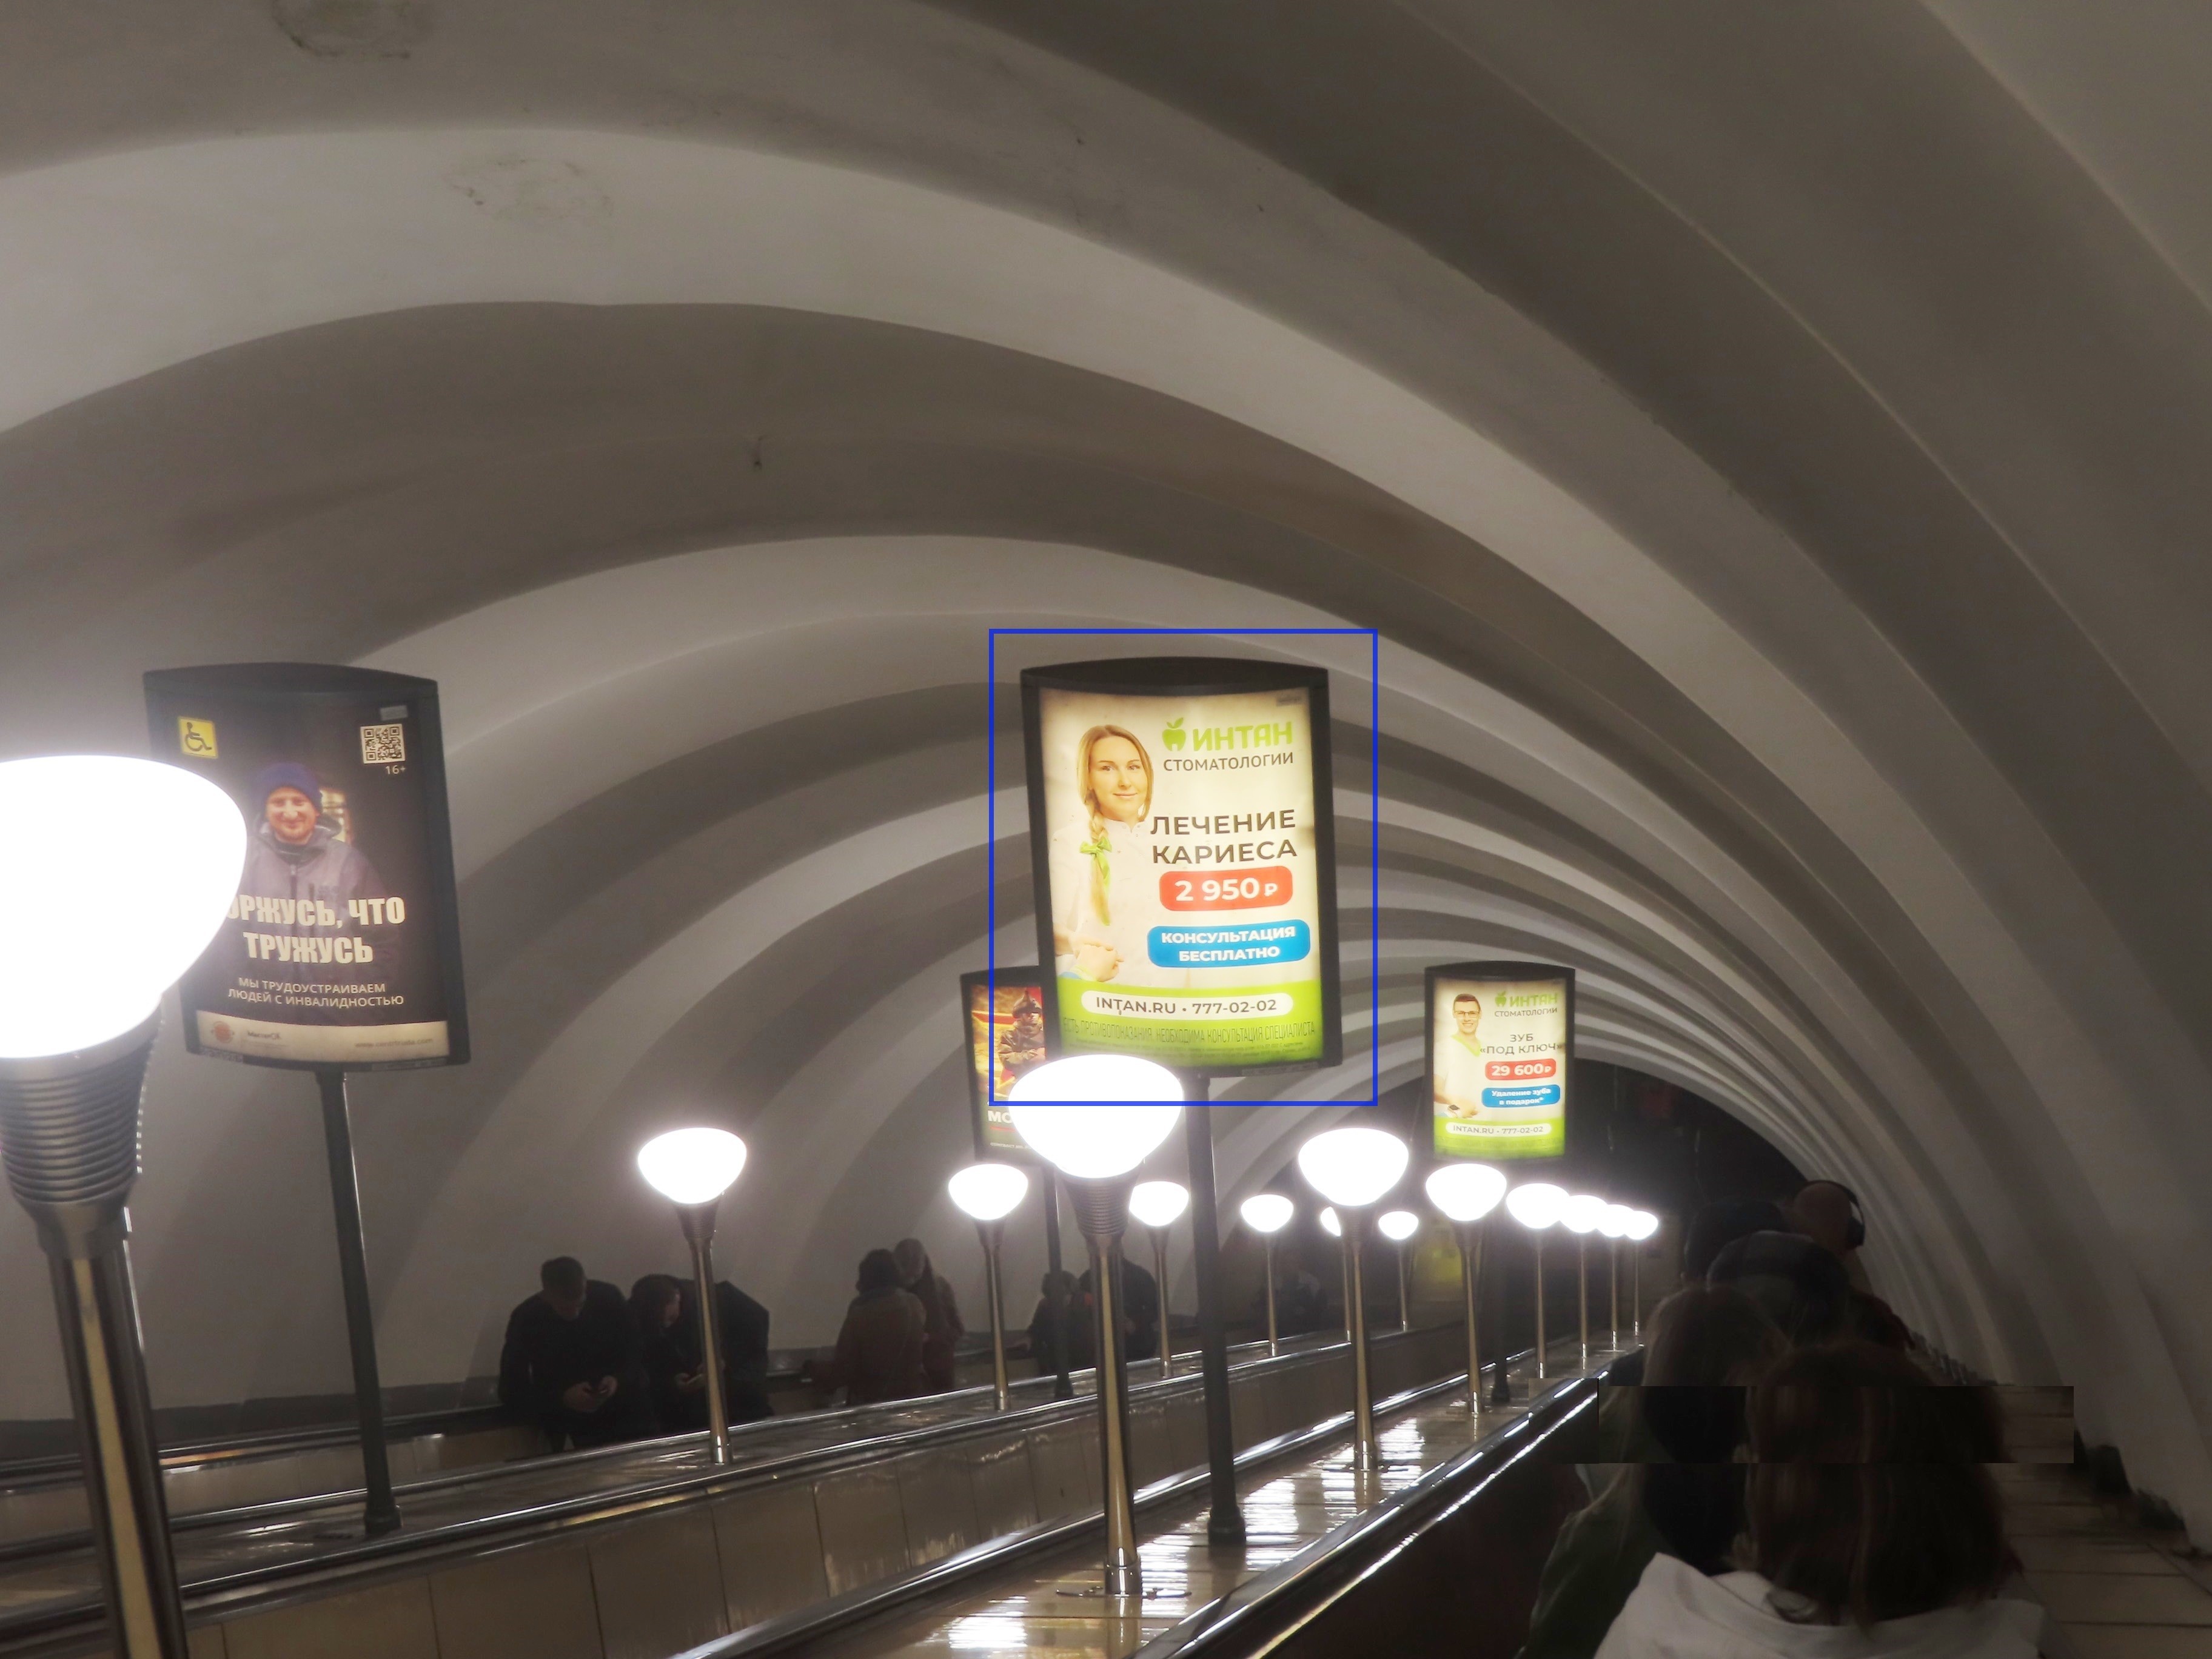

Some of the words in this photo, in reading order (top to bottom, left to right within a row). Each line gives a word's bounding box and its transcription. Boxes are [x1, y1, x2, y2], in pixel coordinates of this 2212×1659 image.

[1192, 721, 1293, 752] ИНТАН
[385, 765, 406, 775] 16+
[1163, 752, 1293, 772] СТОМАТОЛОГИИ
[1150, 809, 1296, 836] ЛЕЧЕНИЕ
[1152, 839, 1298, 865] КАРИЕСА
[227, 894, 343, 929] ОРЖУСЬ,
[347, 896, 406, 926] ЧТО
[1161, 925, 1296, 944] КОНСУЛЬТАЦИЯ
[243, 931, 374, 964] ТРУЖУСЬ
[1178, 946, 1281, 962] БЕСПЛАТНО
[238, 977, 259, 988] МЫ
[261, 980, 386, 994] ТРУДОУСТРАИВАЕМ
[228, 988, 272, 1003] ЛЮДЕЙ
[274, 995, 282, 1004] С
[286, 995, 404, 1008] ИНВАЛИДНОСТЬЮ
[1096, 996, 1176, 1014] INTAN.RU
[1191, 999, 1278, 1014] 777-02-02
[1509, 992, 1558, 1008] ИНТАН
[1494, 1008, 1558, 1017] СТОМАТОЛОГИИ
[1207, 1026, 1263, 1043] КОНСУЛЬТАЦИЯ
[1264, 1021, 1315, 1041] СПЕЦИАЛИСТА
[1509, 1033, 1533, 1043] ЗУБ
[1480, 1045, 1515, 1055] «ПОД
[1491, 1065, 1510, 1076] 29
[1532, 1087, 1552, 1096] зуба
[1453, 1125, 1494, 1134] INTAN.RU
[1501, 1125, 1543, 1134] 777-02-02
